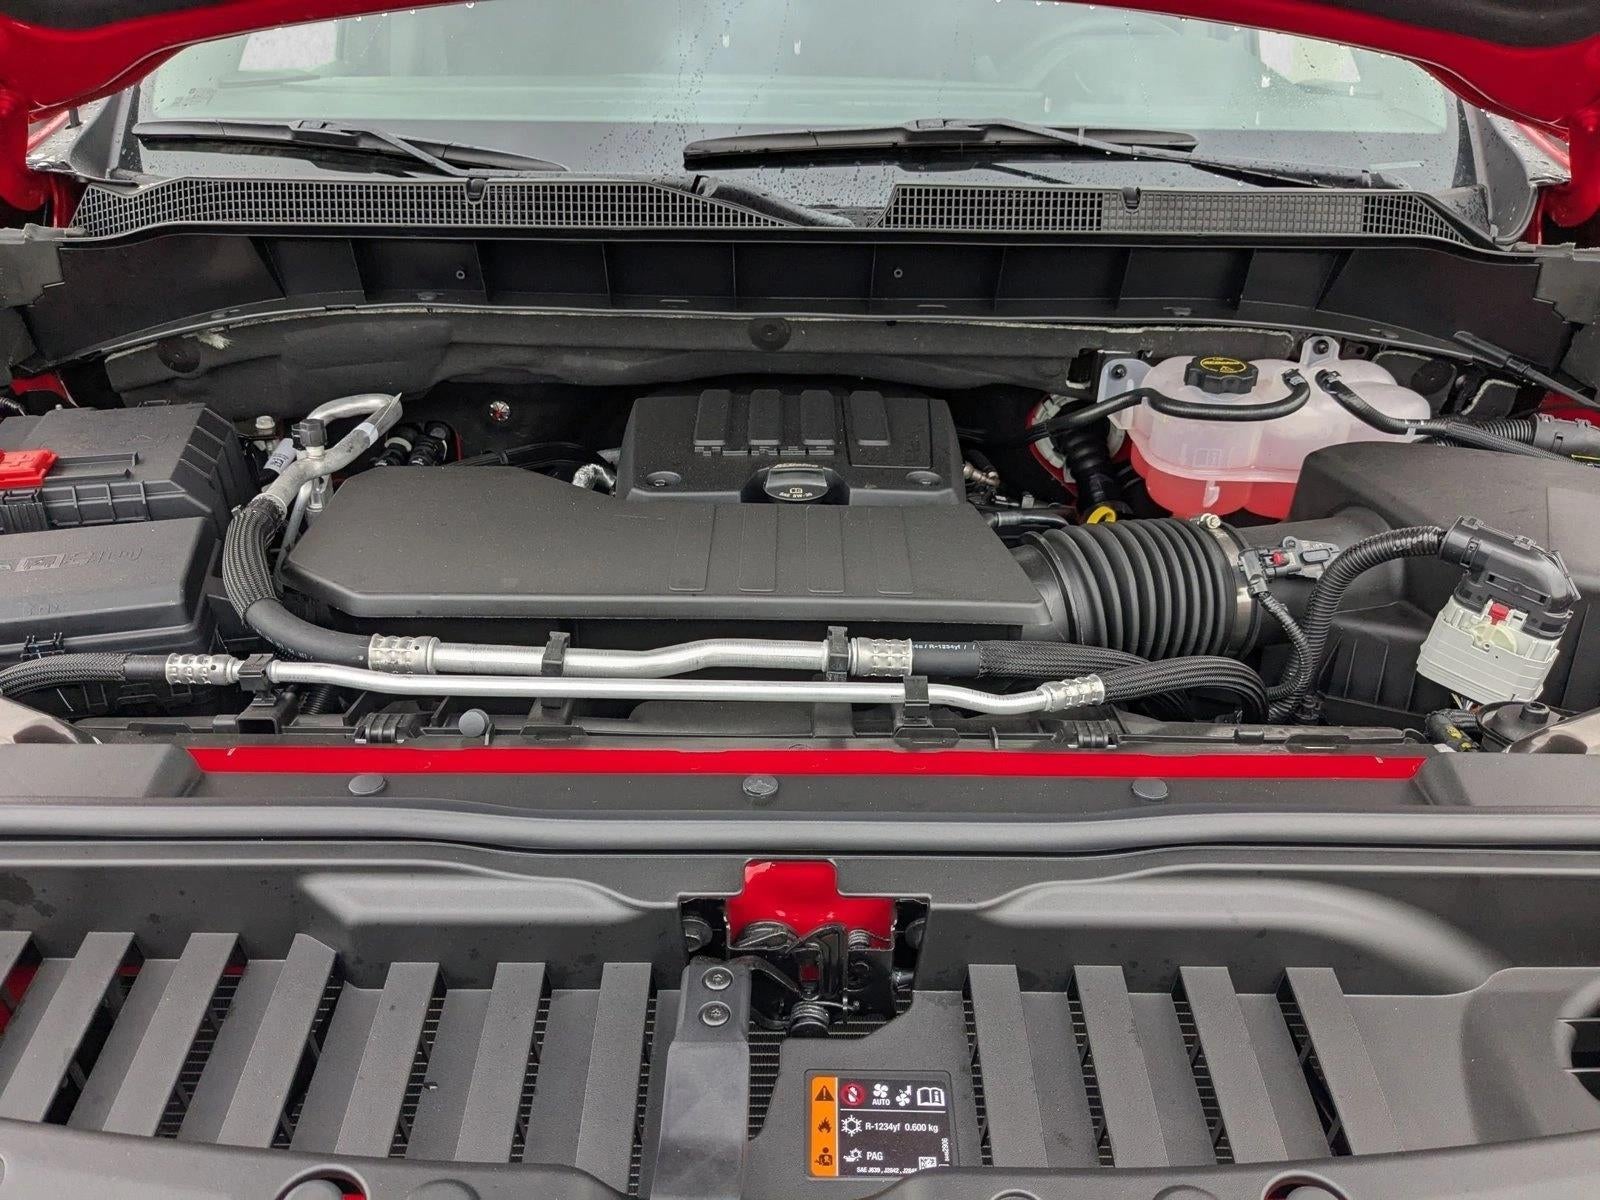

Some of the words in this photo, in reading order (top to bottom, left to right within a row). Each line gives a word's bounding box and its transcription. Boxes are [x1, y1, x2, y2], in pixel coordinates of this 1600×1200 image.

[872, 1098, 891, 1106] AUTO
[865, 1122, 900, 1132] R-1234yf
[904, 1123, 927, 1131] 0.600
[928, 1123, 939, 1134] kg
[866, 1151, 884, 1161] PAG
